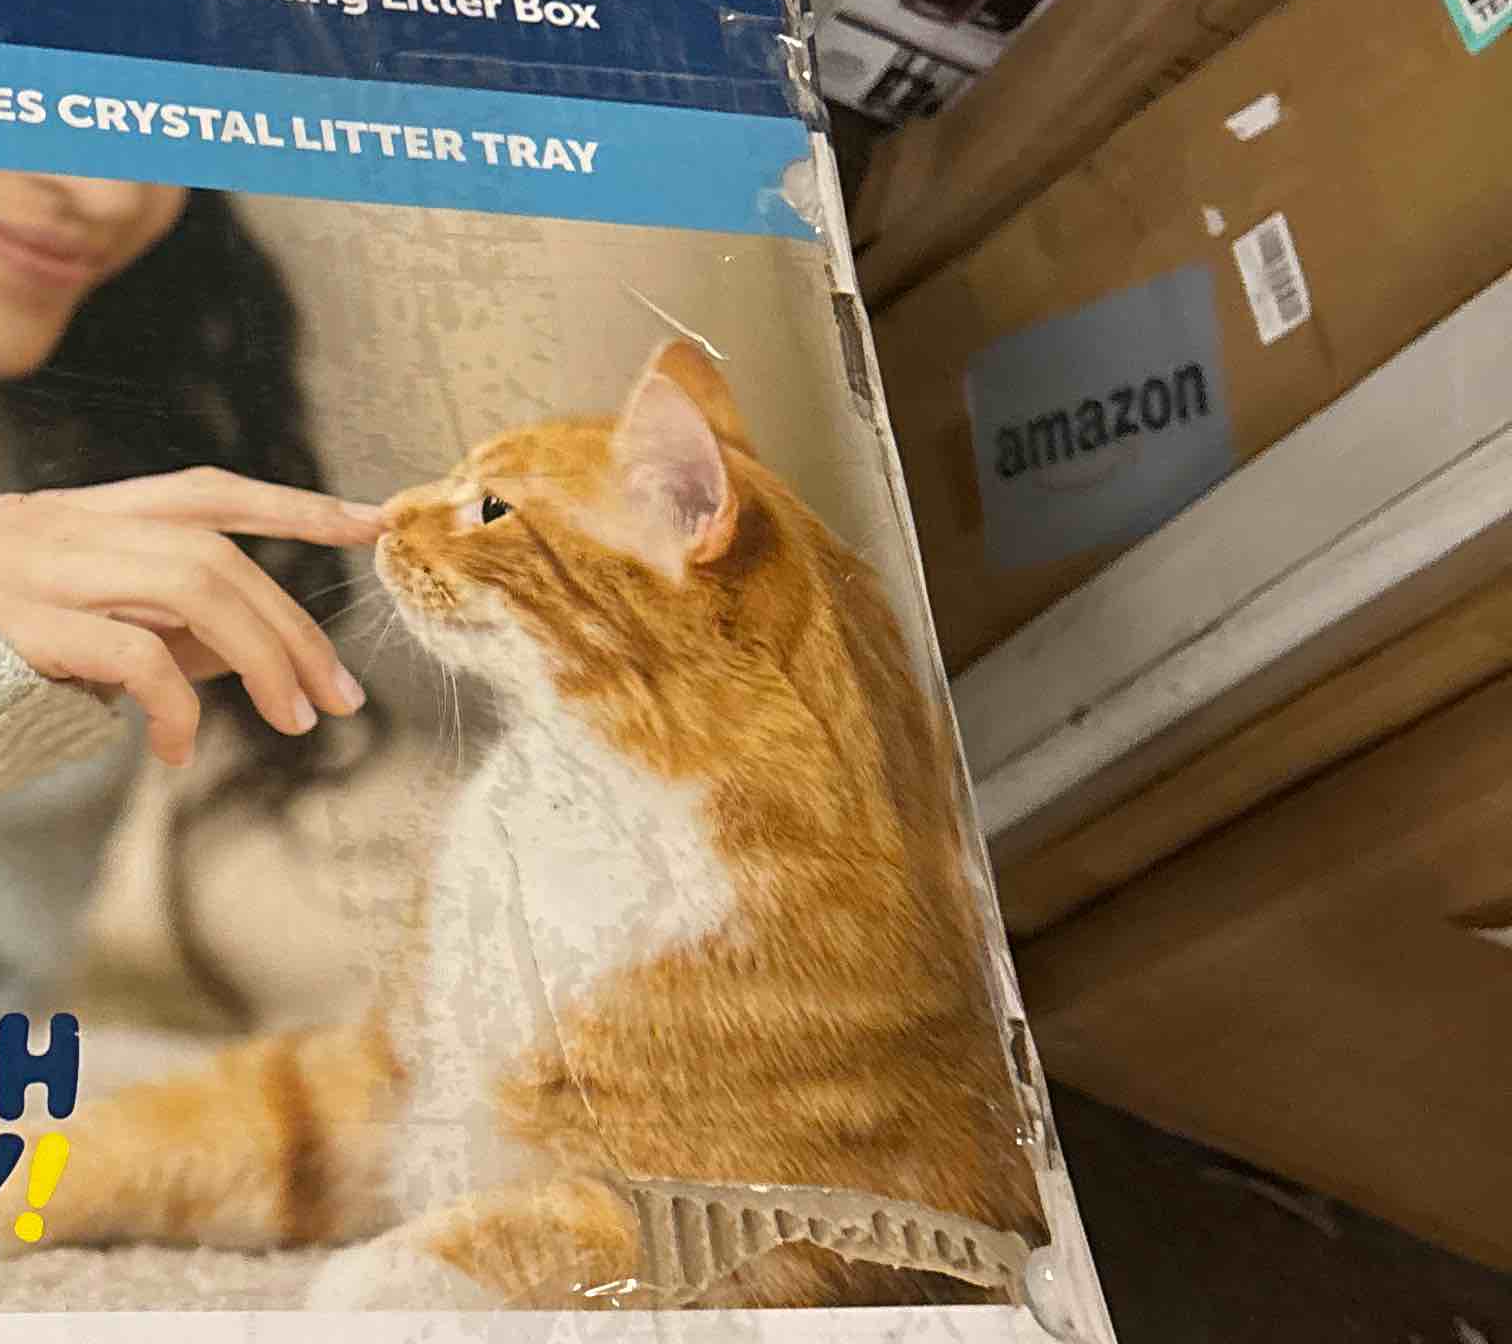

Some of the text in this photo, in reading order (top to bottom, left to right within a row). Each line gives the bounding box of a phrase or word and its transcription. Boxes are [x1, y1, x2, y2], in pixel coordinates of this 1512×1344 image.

[56, 92, 285, 148] CRYSTAL
[292, 116, 468, 164] LITTER
[471, 131, 600, 174] TRAY
[993, 362, 1209, 480] amazon
